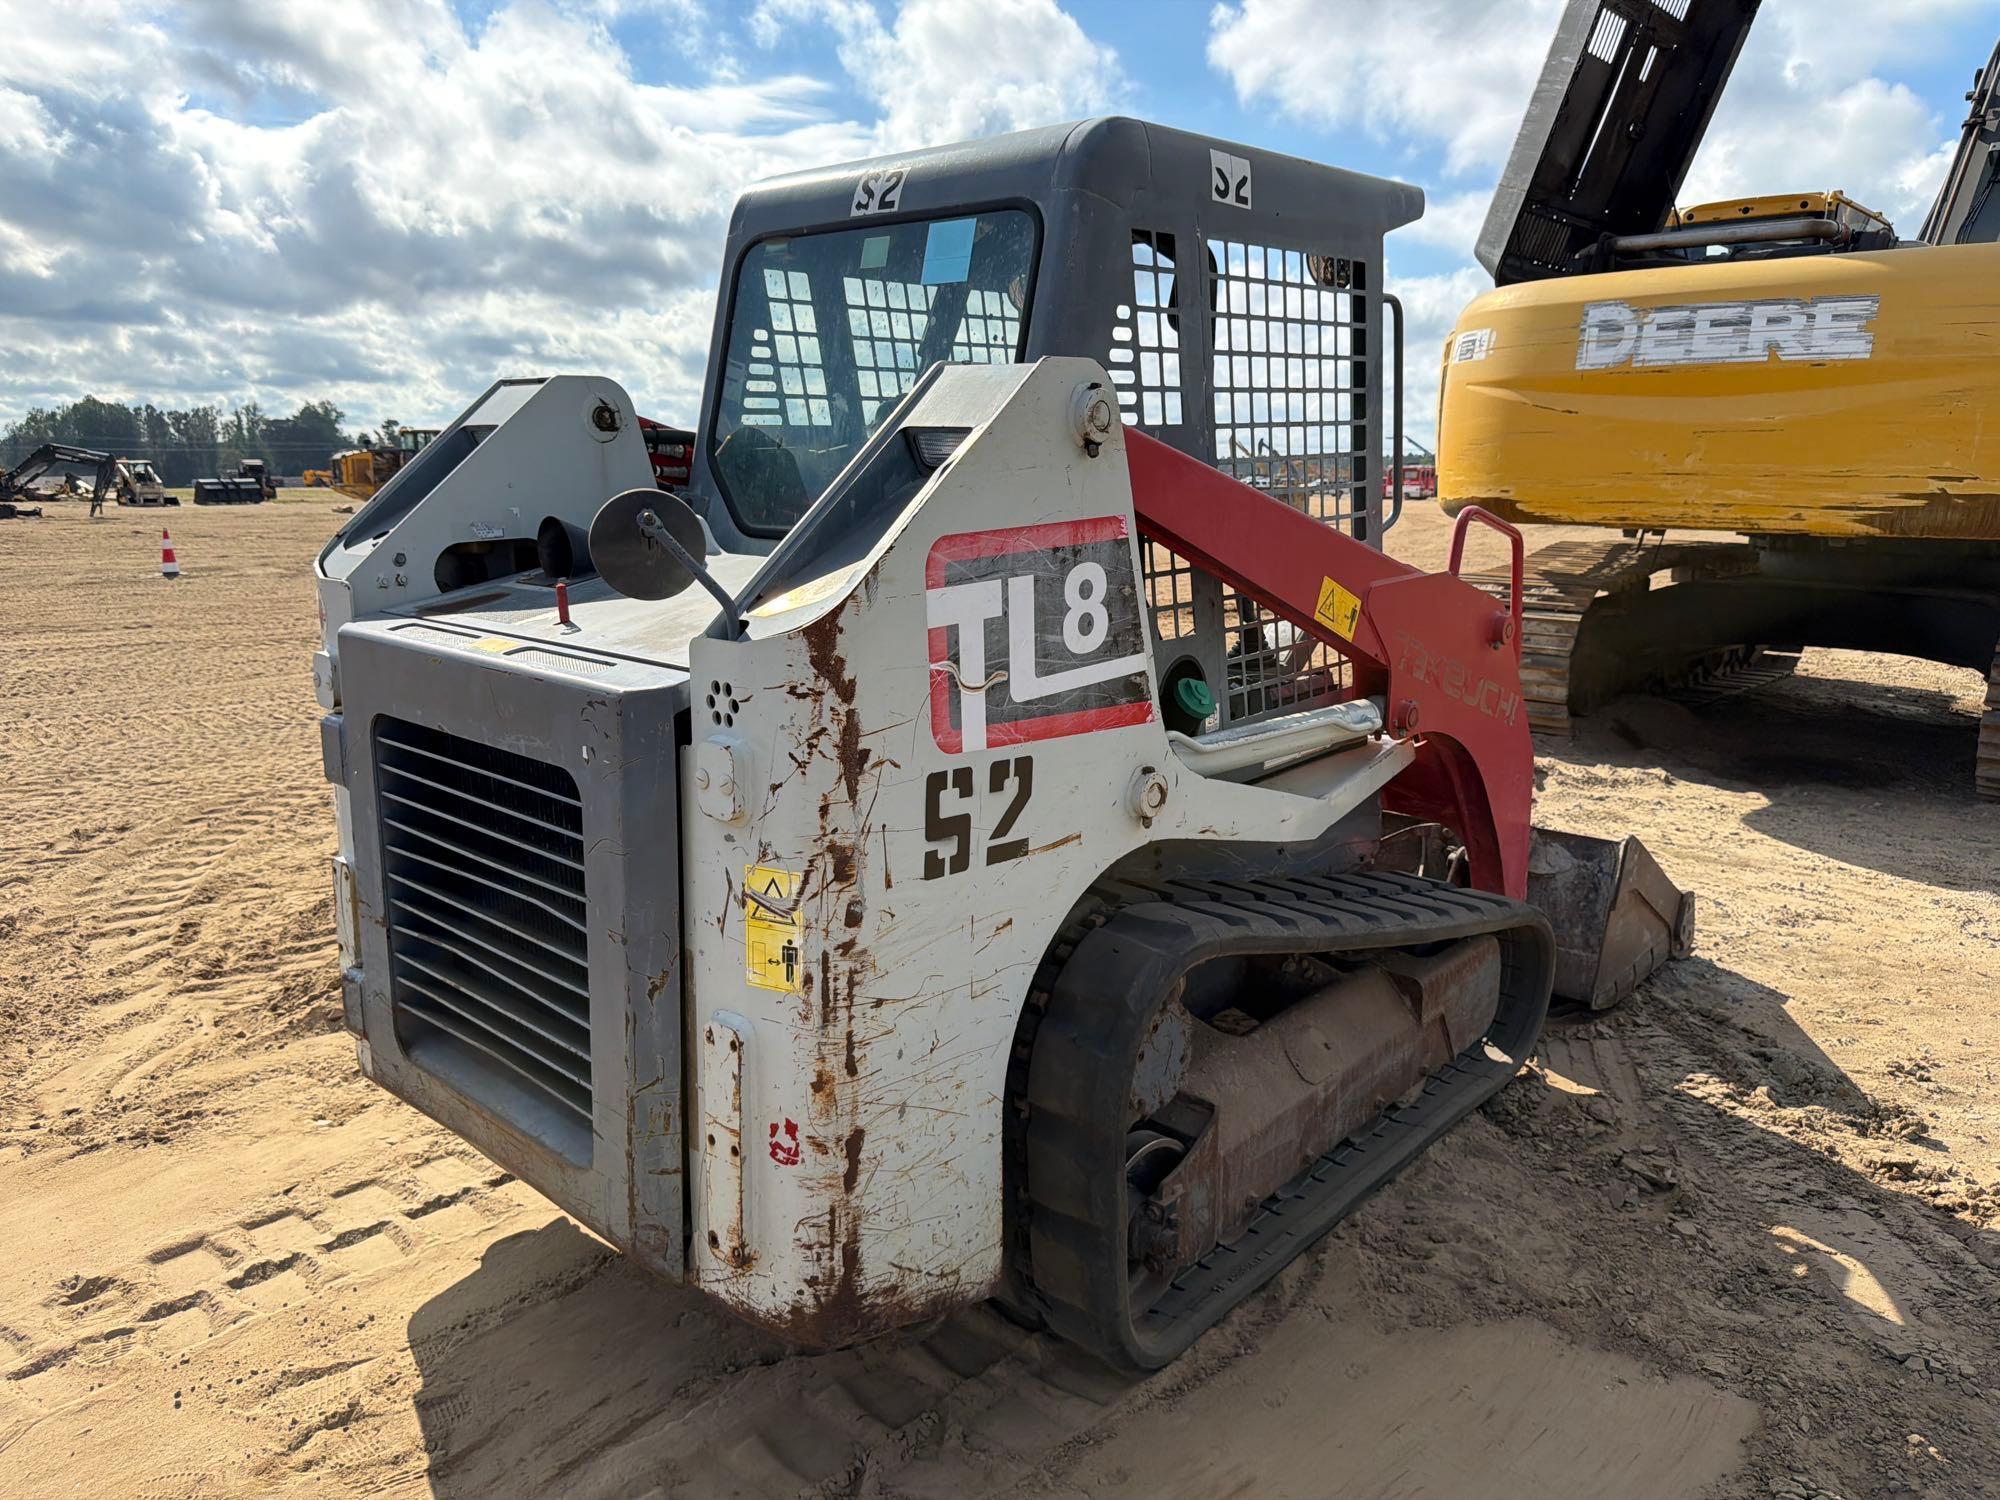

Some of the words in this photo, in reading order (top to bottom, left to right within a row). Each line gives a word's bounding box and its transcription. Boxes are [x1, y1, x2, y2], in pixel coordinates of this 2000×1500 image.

[855, 170, 904, 211] S2
[1575, 294, 1880, 369] DEERE
[924, 755, 1034, 881] S2
